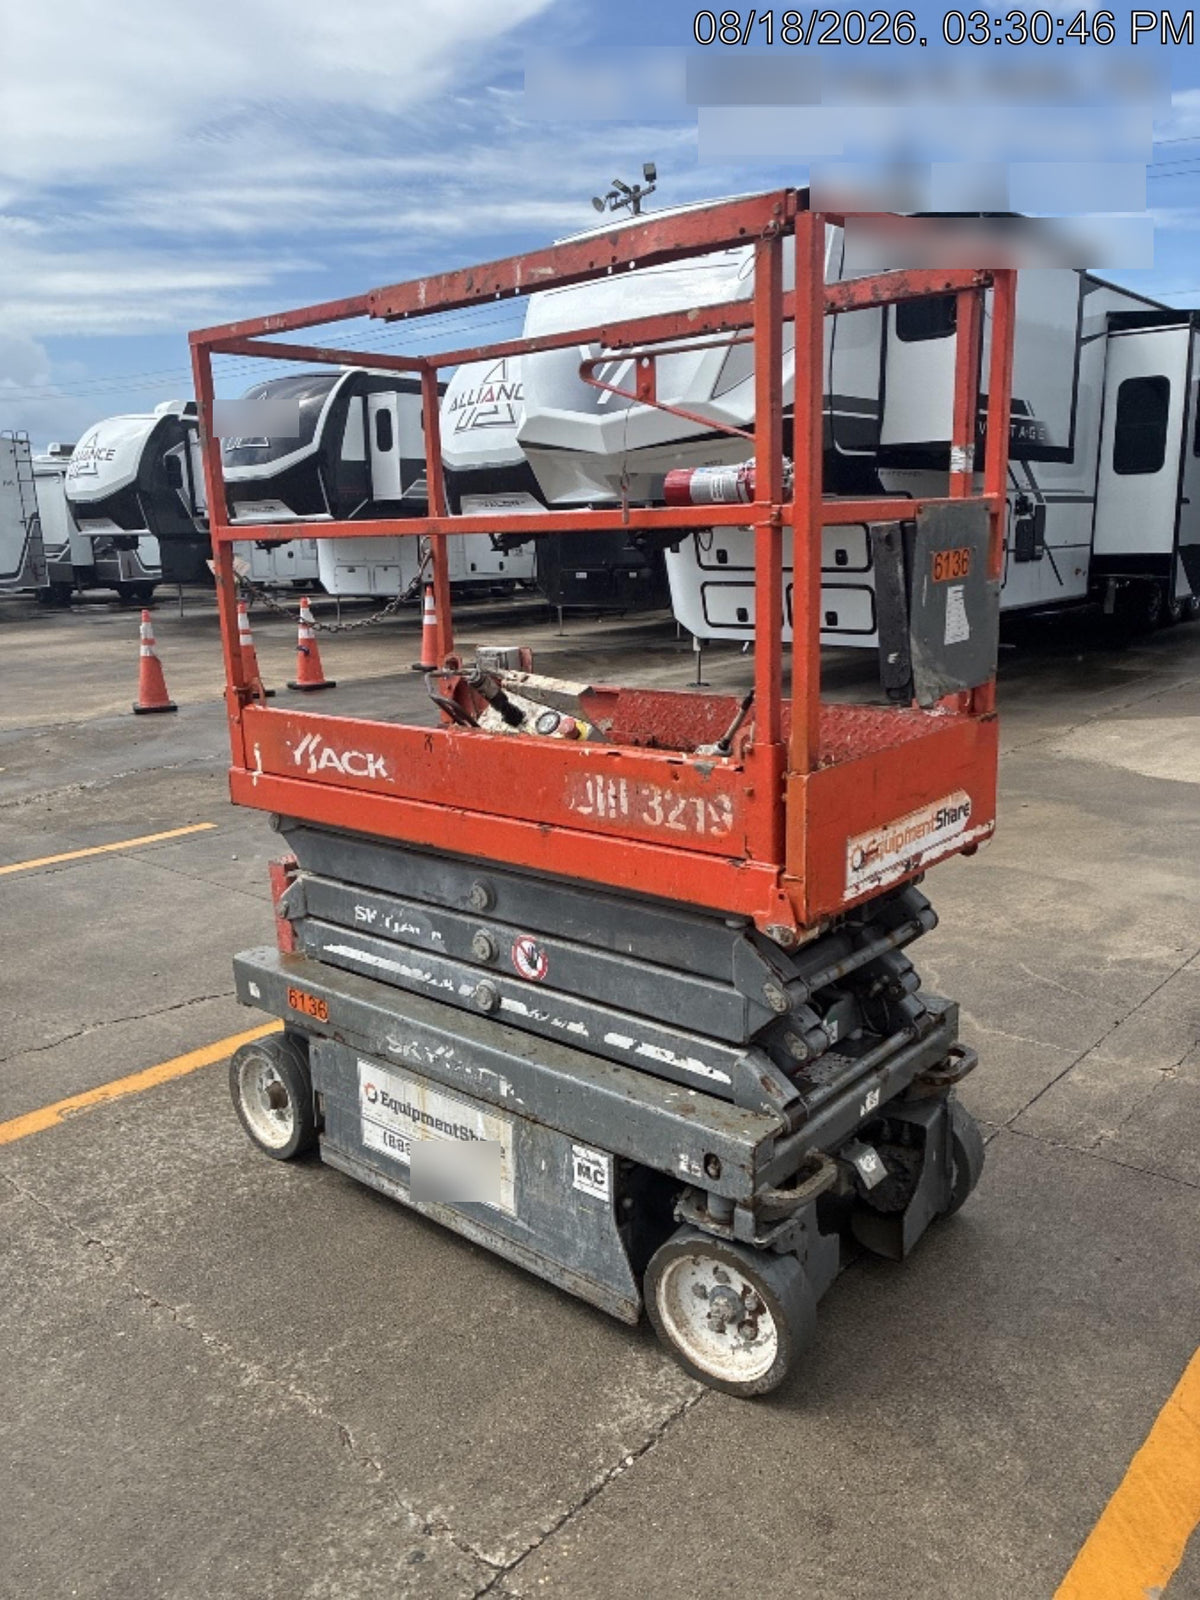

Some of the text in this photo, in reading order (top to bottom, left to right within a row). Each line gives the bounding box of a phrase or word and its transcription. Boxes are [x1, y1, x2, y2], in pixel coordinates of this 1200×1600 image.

[449, 383, 526, 414] ALLIANC
[978, 421, 1047, 441] VTAGE
[934, 548, 970, 580] 6136
[866, 802, 971, 865] EquipmentShare
[288, 989, 328, 1020] 6136
[380, 1090, 506, 1160] EquipmentSh
